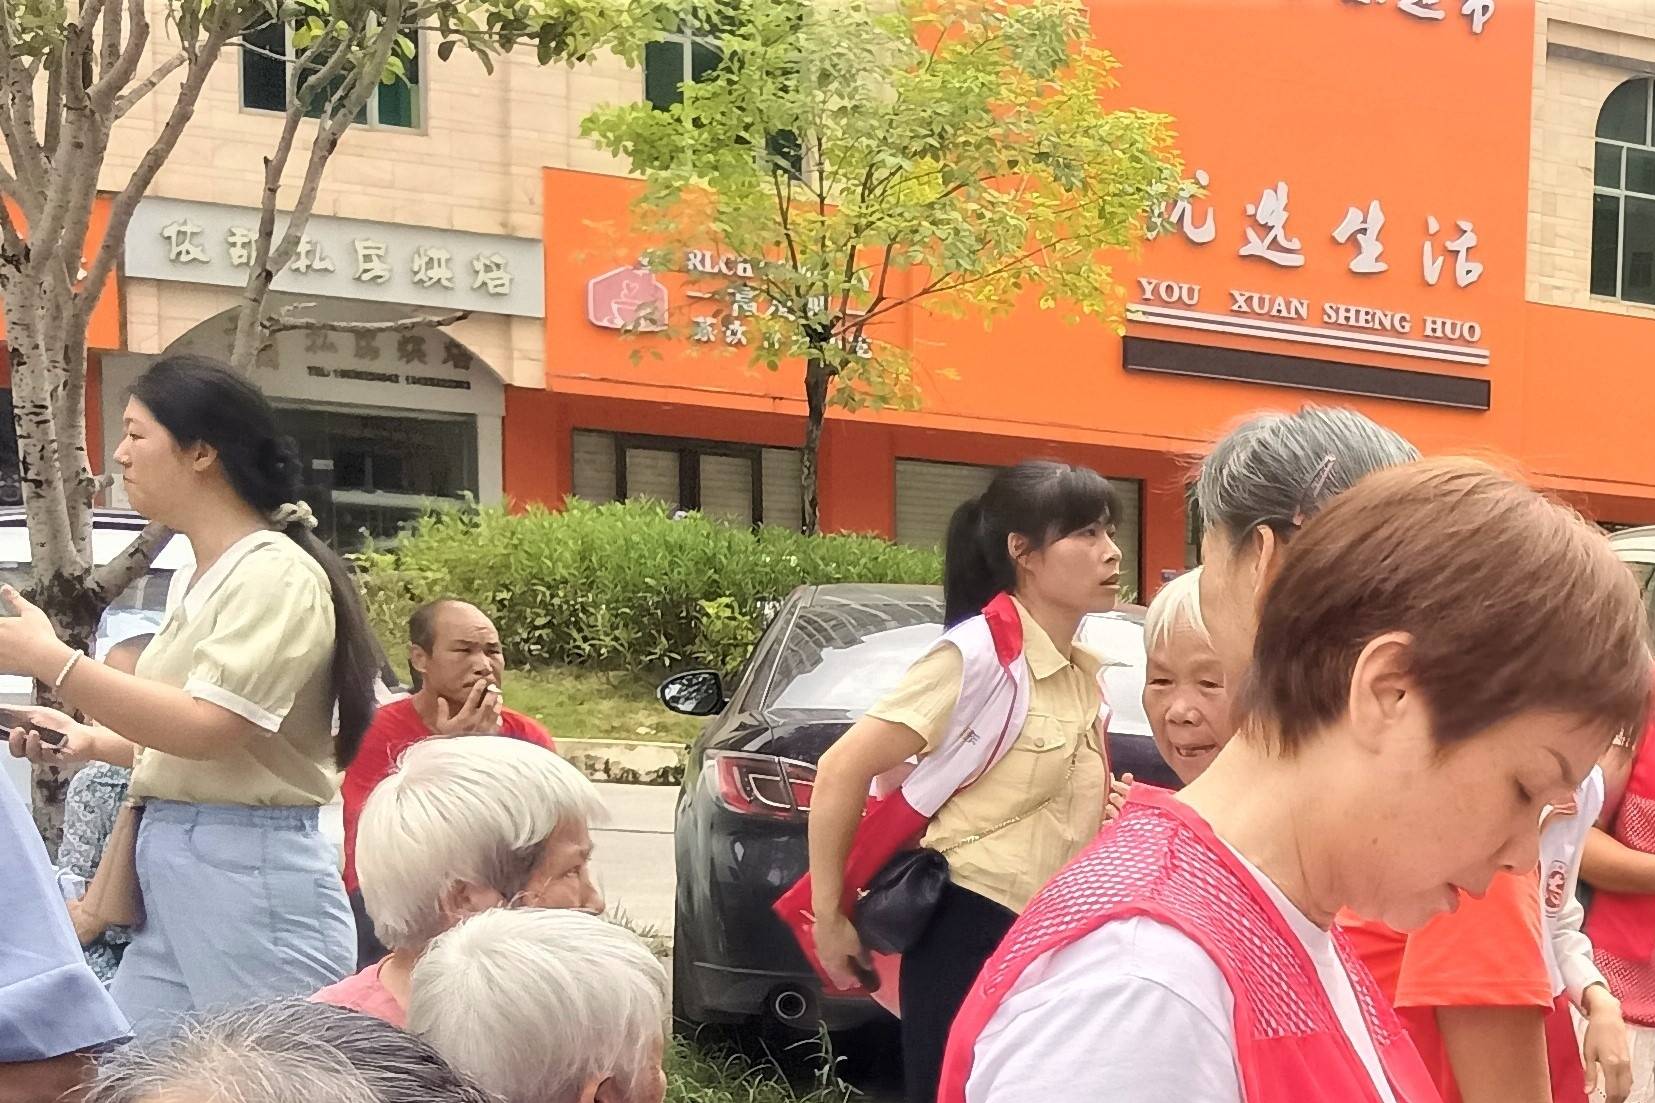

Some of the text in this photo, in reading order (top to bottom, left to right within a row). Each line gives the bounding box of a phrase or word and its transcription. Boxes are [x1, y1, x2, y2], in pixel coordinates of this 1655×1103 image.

[1137, 277, 1482, 342] YOU XUAN SHENG HUO
